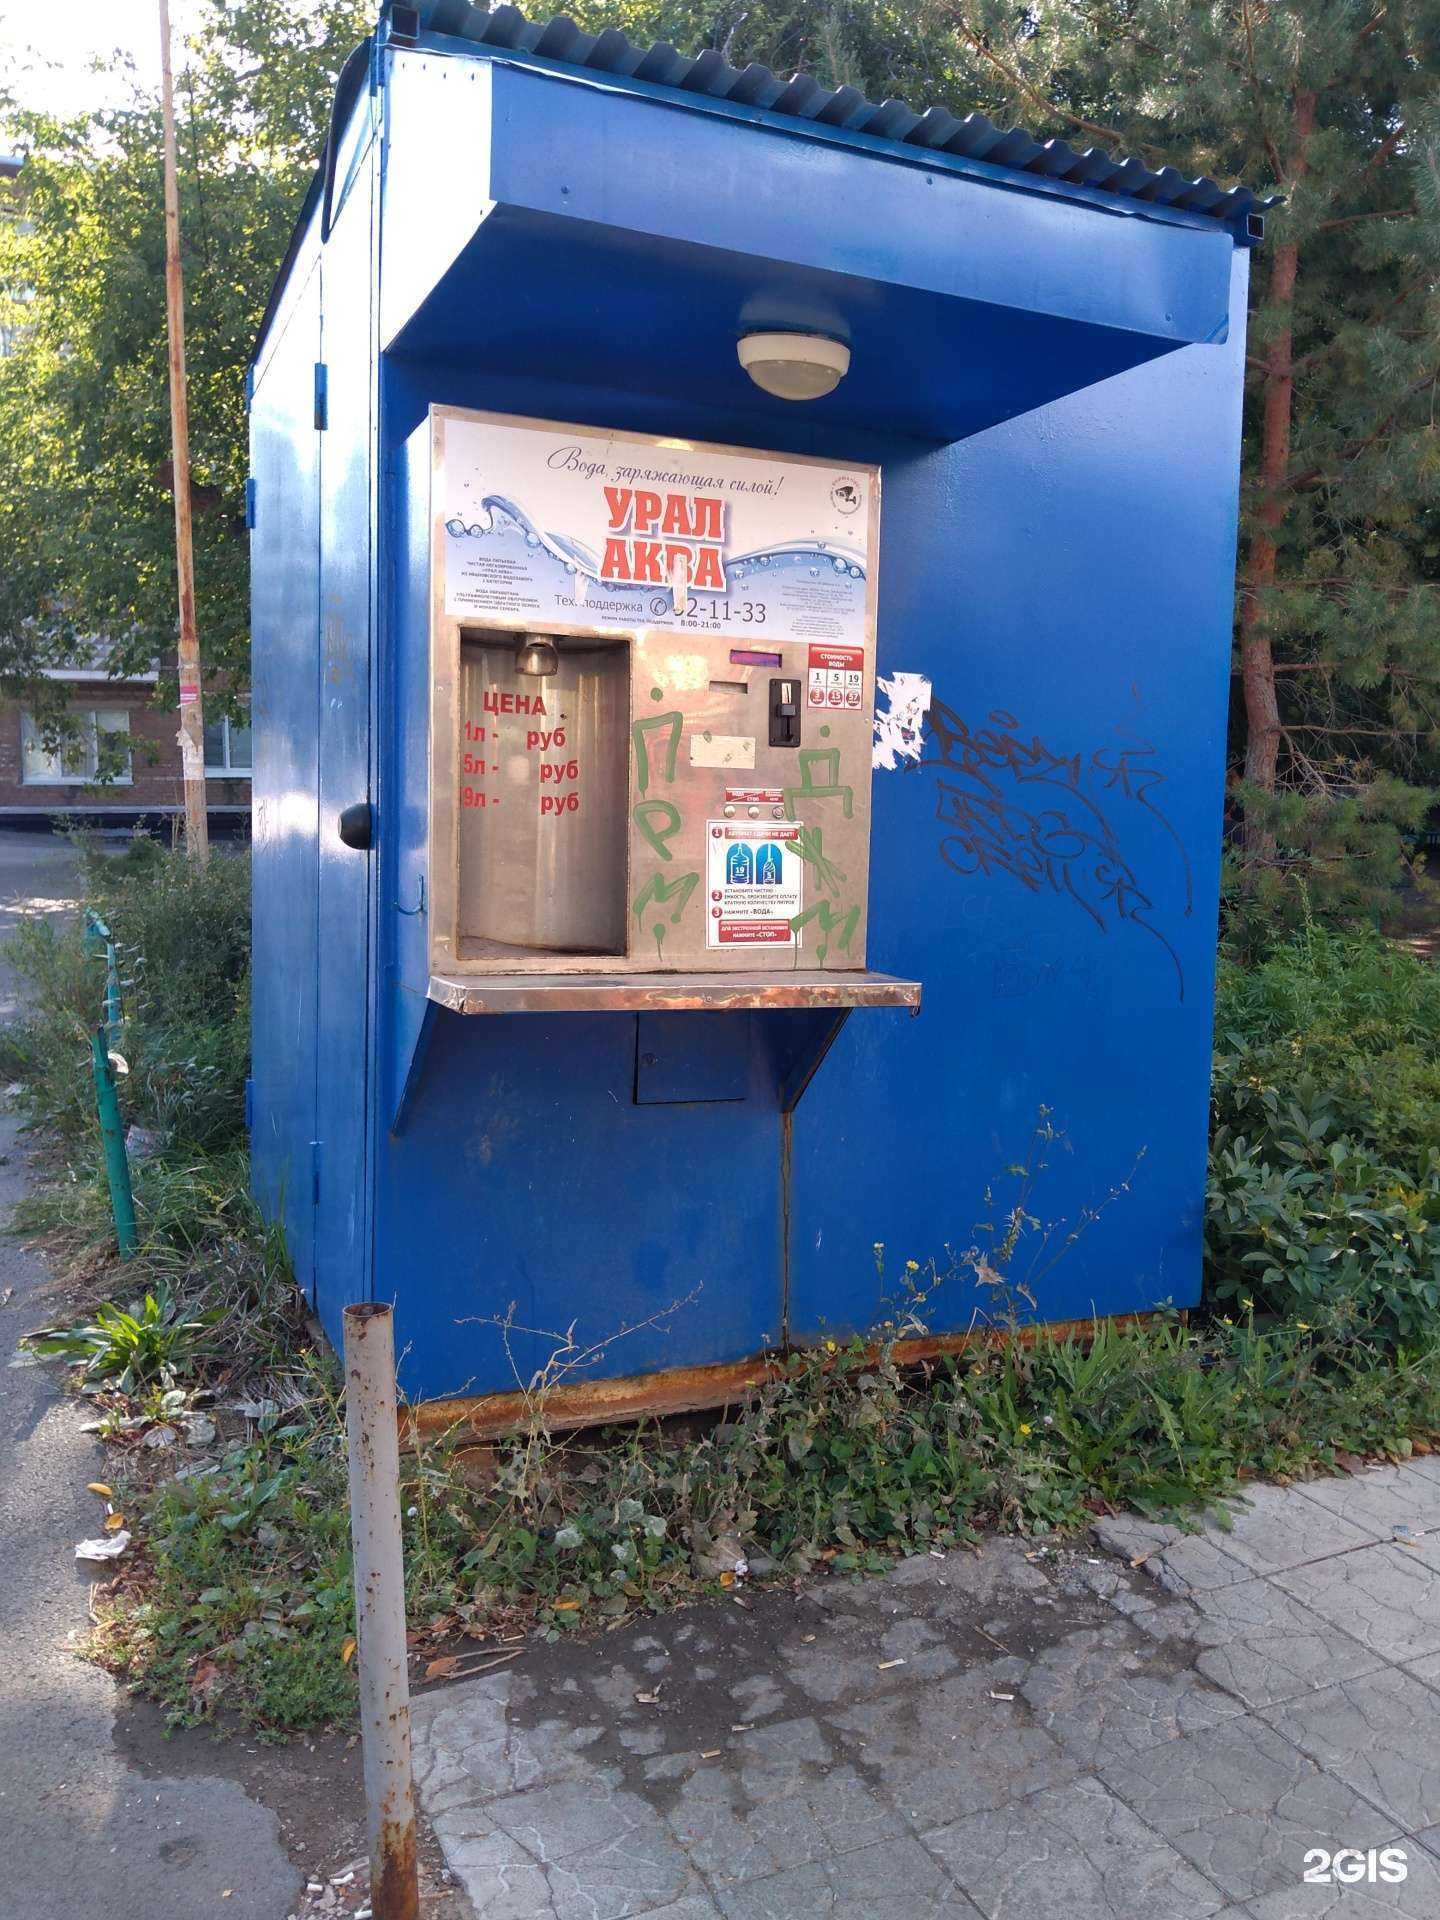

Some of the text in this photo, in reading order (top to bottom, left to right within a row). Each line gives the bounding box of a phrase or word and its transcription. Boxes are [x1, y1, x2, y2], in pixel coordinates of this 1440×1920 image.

[547, 446, 784, 496] Вода, заряжающая силой!
[603, 486, 723, 540] УРАЛ
[673, 597, 766, 623] 2-11-33
[680, 619, 721, 630] 8:00-21:00
[834, 673, 839, 681] 5
[483, 691, 547, 716] ЦЕНА
[464, 720, 486, 741] 1л
[526, 727, 566, 751] руб
[463, 754, 486, 775] 5л
[540, 760, 579, 784] руб
[541, 792, 579, 816] руб
